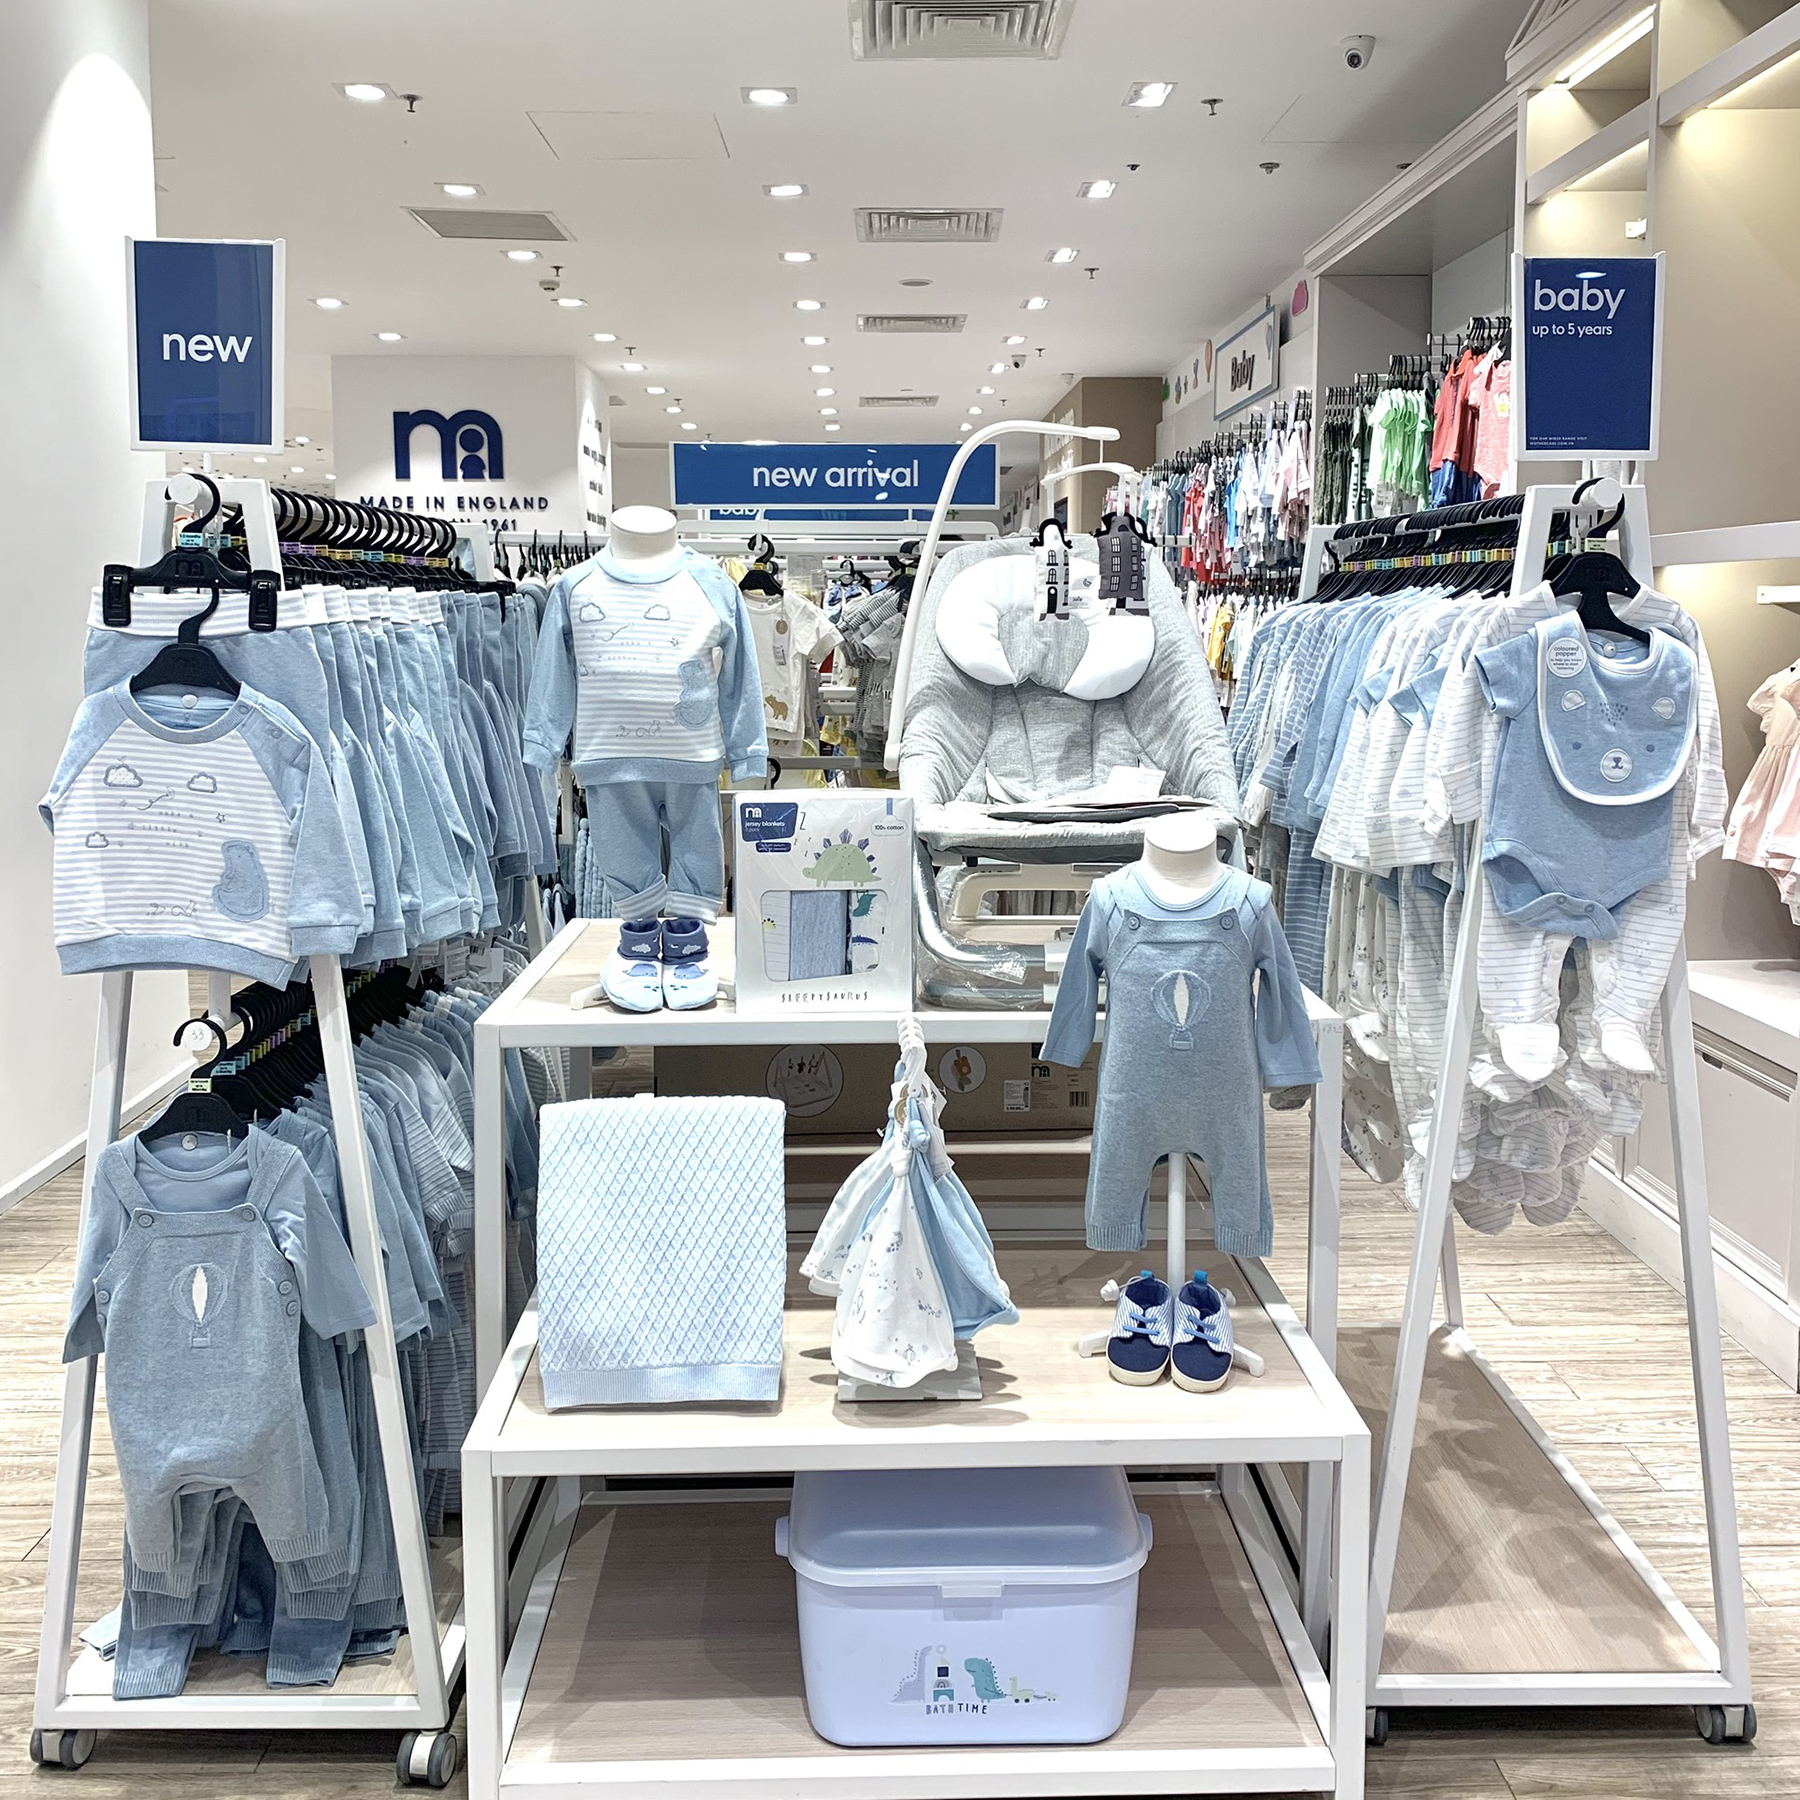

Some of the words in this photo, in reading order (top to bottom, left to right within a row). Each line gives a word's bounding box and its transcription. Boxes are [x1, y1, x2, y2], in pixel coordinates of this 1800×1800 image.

[1534, 279, 1626, 319] baby
[1532, 326, 1549, 338] up
[1552, 324, 1565, 335] to
[1568, 323, 1575, 335] 5
[1578, 325, 1613, 338] years
[163, 333, 253, 362] new
[1230, 350, 1255, 392] Baby
[753, 467, 818, 487] new
[825, 459, 919, 487] arrival
[360, 496, 414, 509] MADE
[426, 496, 445, 509] IN
[458, 496, 549, 509] ENGLAND
[782, 992, 868, 1003] SLEEPYSAURUS
[191, 1028, 204, 1040] 33
[926, 1704, 954, 1715] BATH
[958, 1703, 987, 1714] TIME
